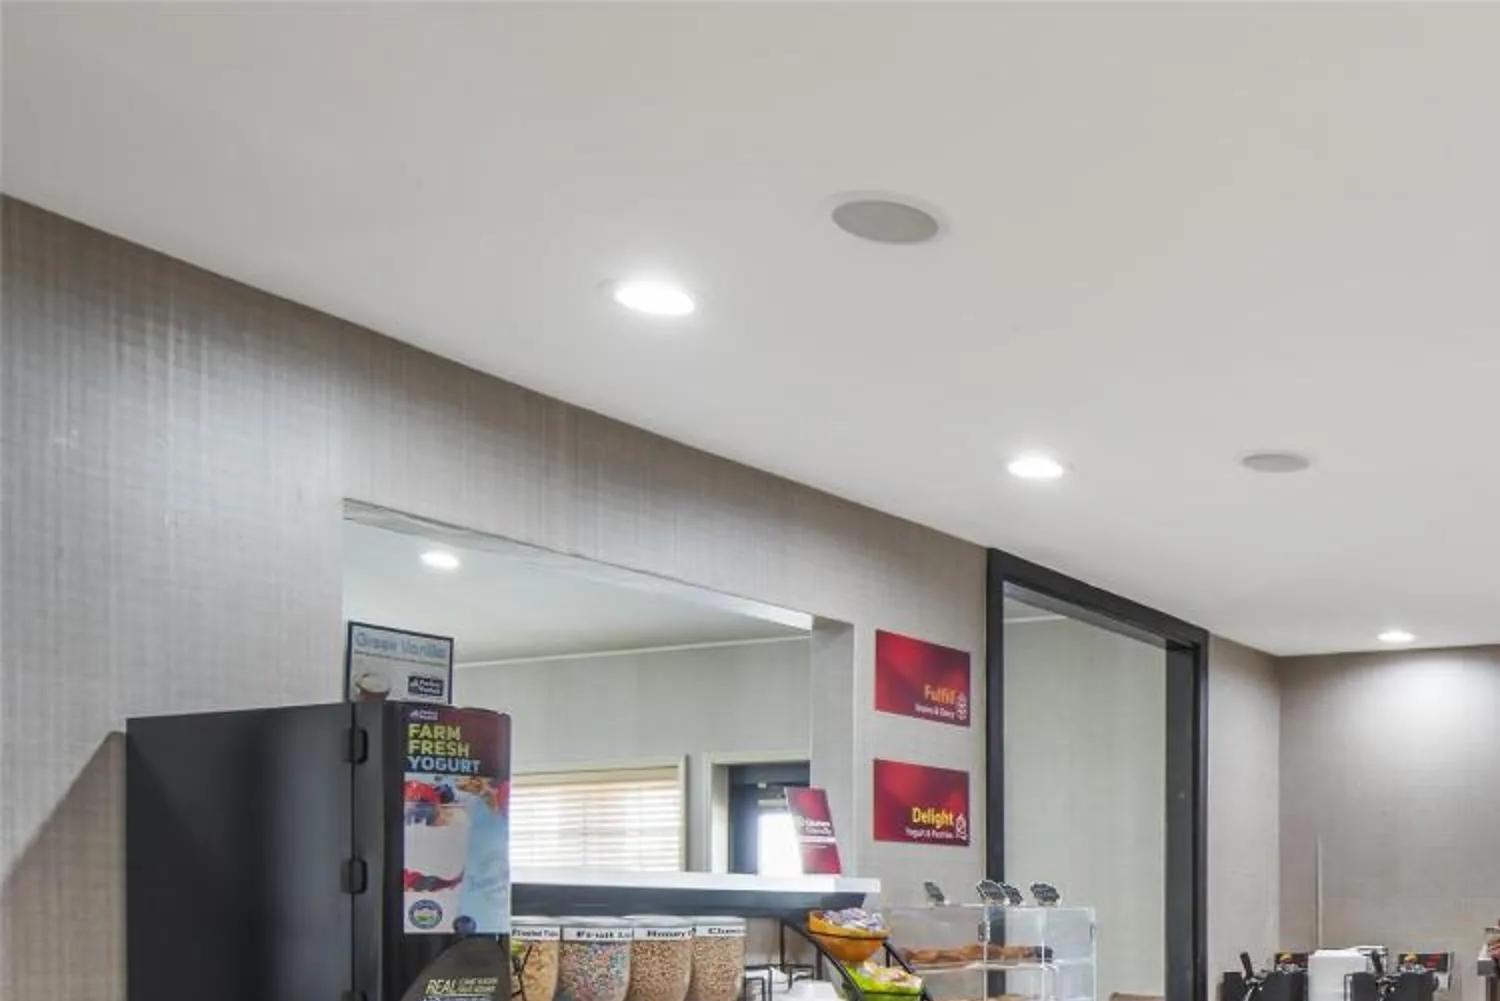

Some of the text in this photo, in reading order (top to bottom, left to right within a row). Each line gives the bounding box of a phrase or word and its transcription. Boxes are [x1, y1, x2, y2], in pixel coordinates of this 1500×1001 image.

[408, 723, 461, 740] FARM
[408, 740, 470, 757] FRESH
[407, 756, 480, 773] YOGURT
[911, 806, 954, 829] Delight
